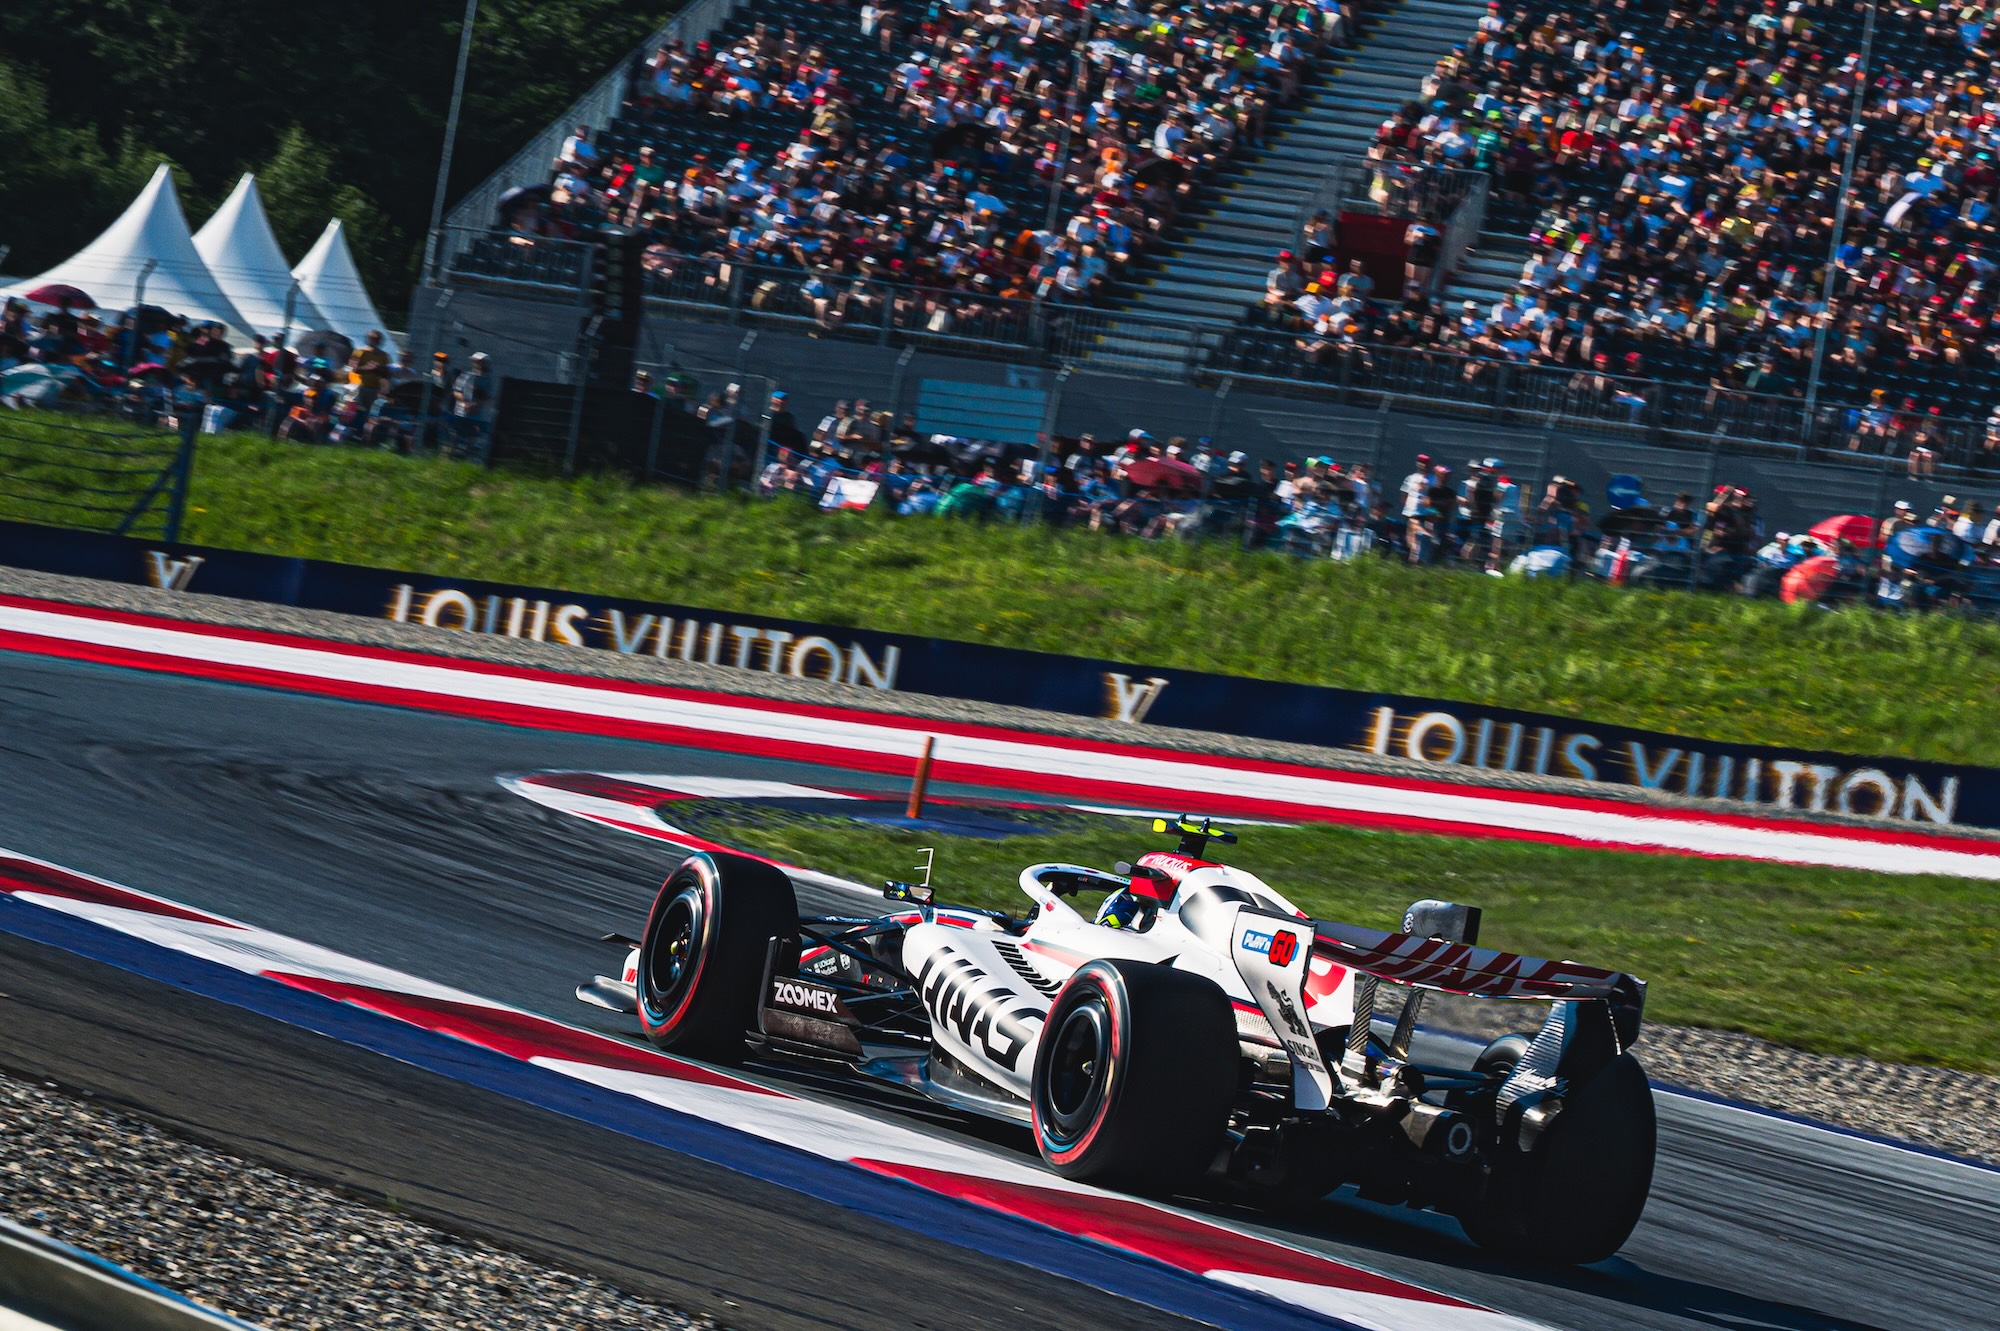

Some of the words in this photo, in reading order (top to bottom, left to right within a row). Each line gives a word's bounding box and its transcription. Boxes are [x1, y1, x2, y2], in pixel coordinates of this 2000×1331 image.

[1152, 854, 1193, 871] RUCKUS
[1269, 930, 1297, 967] GO
[774, 981, 838, 1013] ZOOMEX
